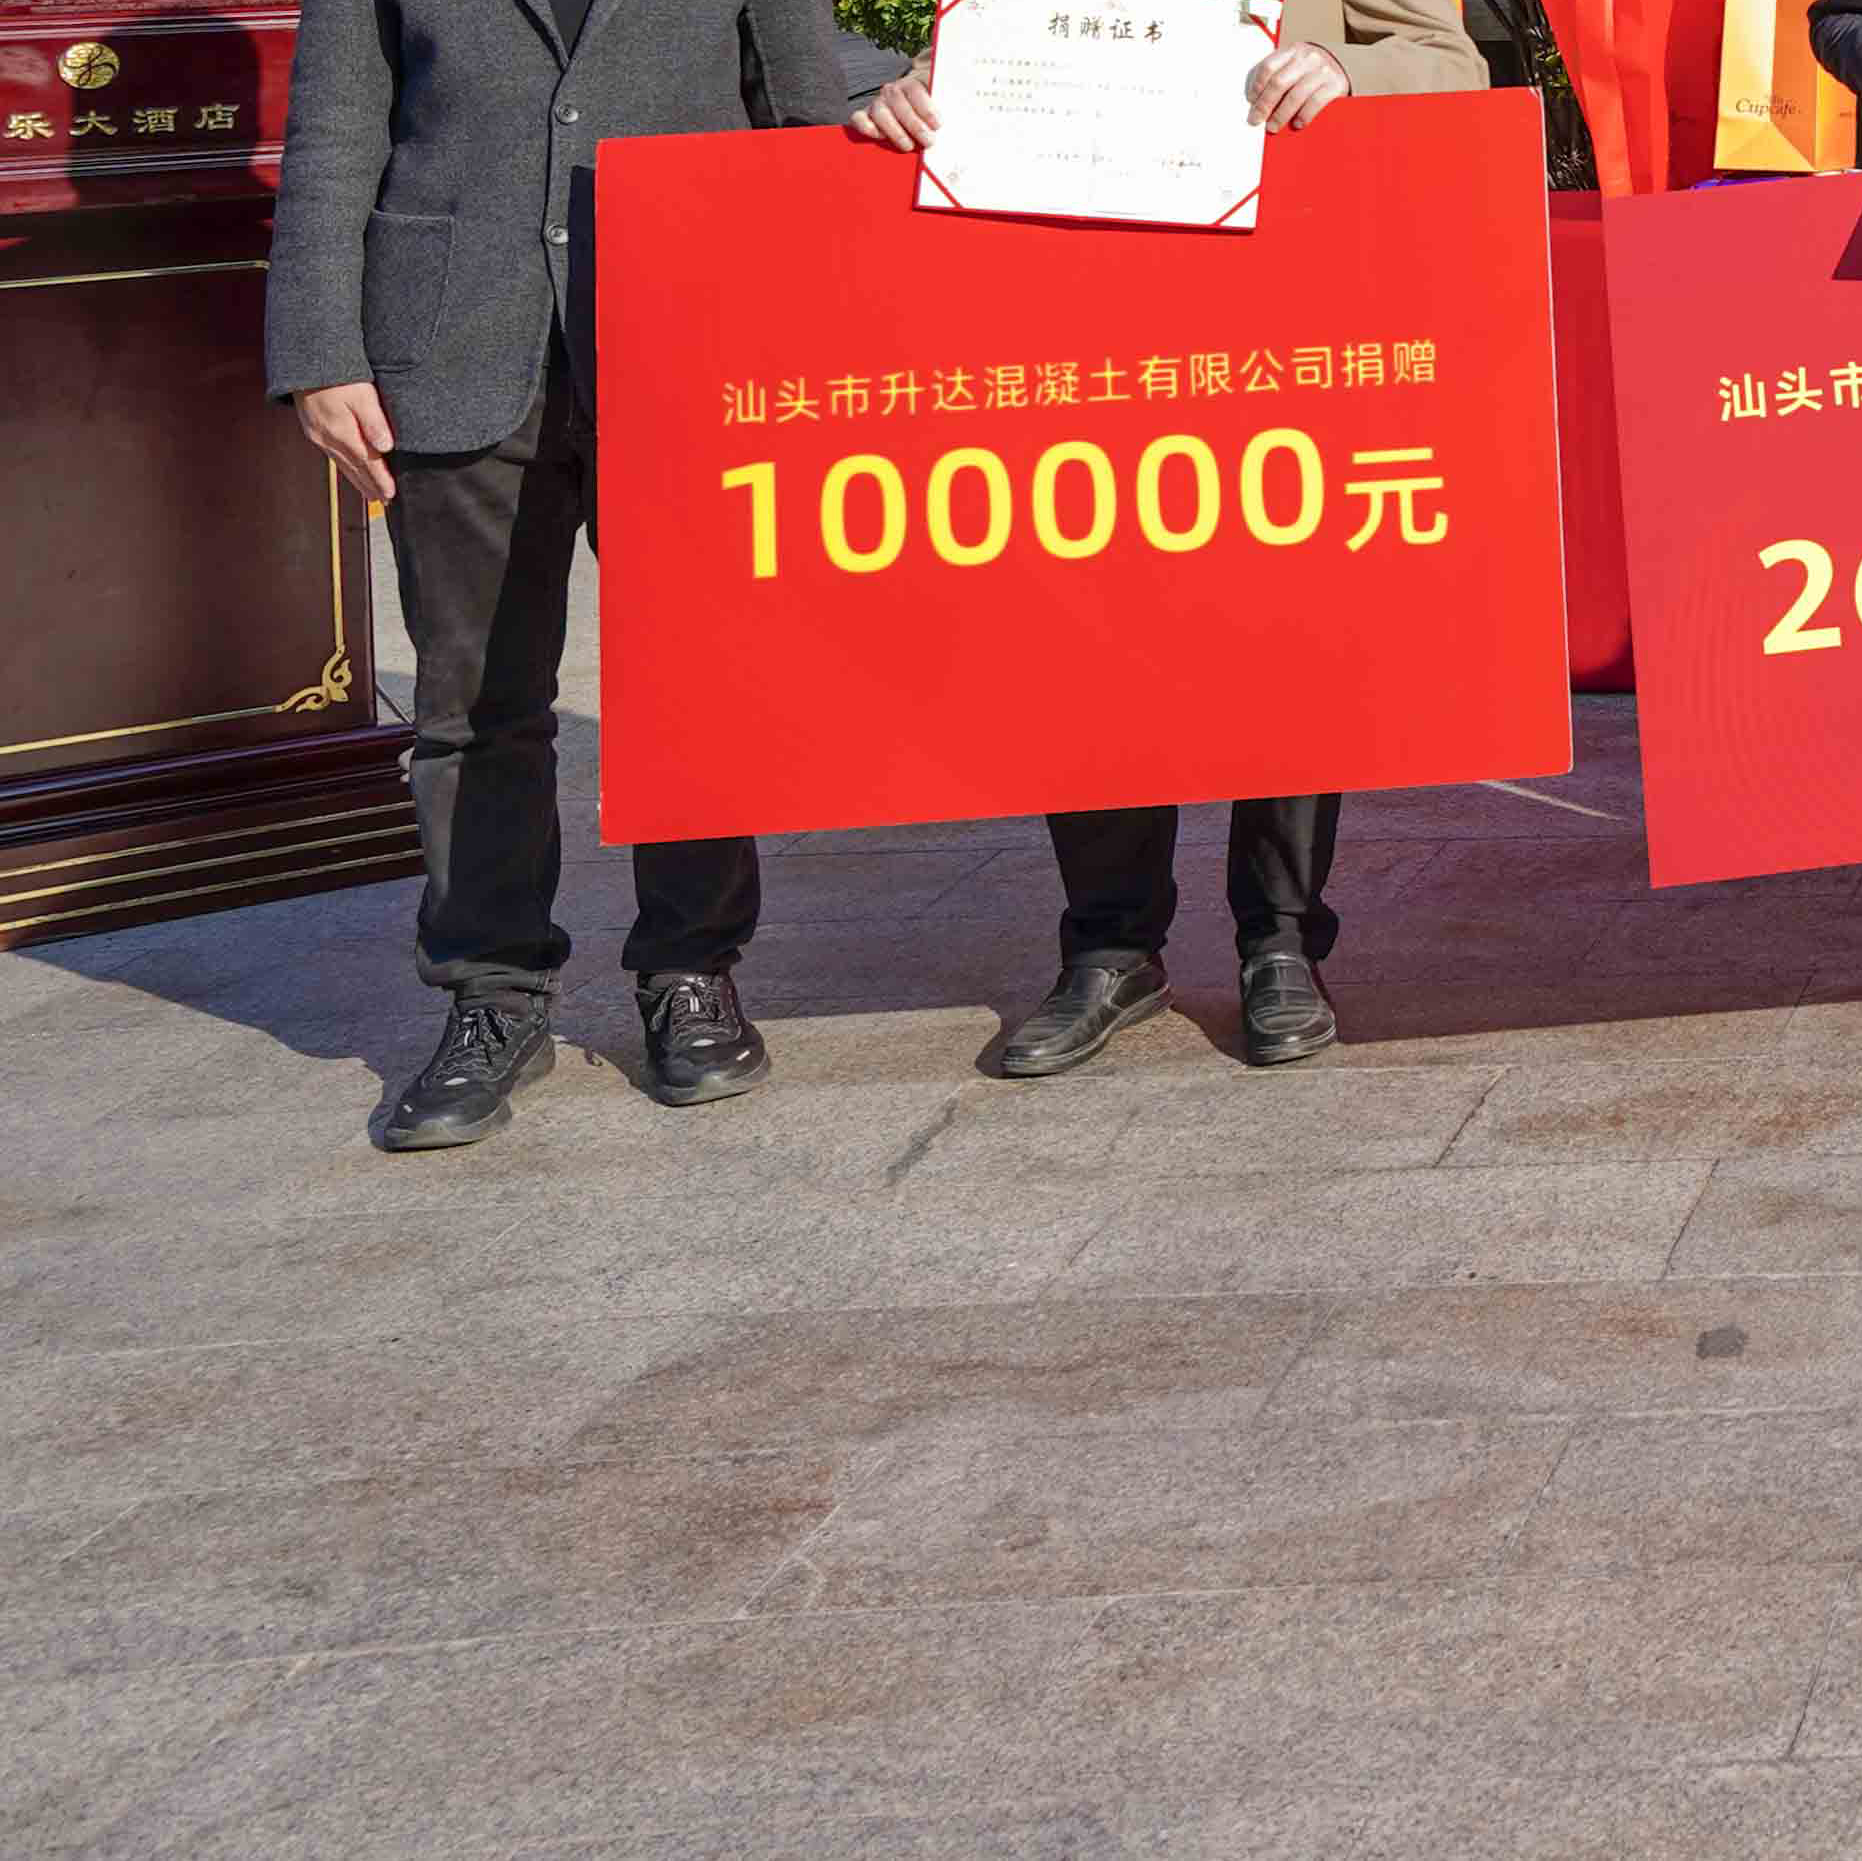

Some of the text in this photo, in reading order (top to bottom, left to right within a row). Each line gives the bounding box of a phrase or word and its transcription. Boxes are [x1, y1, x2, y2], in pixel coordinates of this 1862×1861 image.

[1047, 11, 1166, 43] 捐赠证书
[3, 103, 241, 140] 乐大酒店
[722, 339, 1436, 426] 汕头市升达混凝土有限公司捐赠
[721, 427, 1449, 579] 100000元
